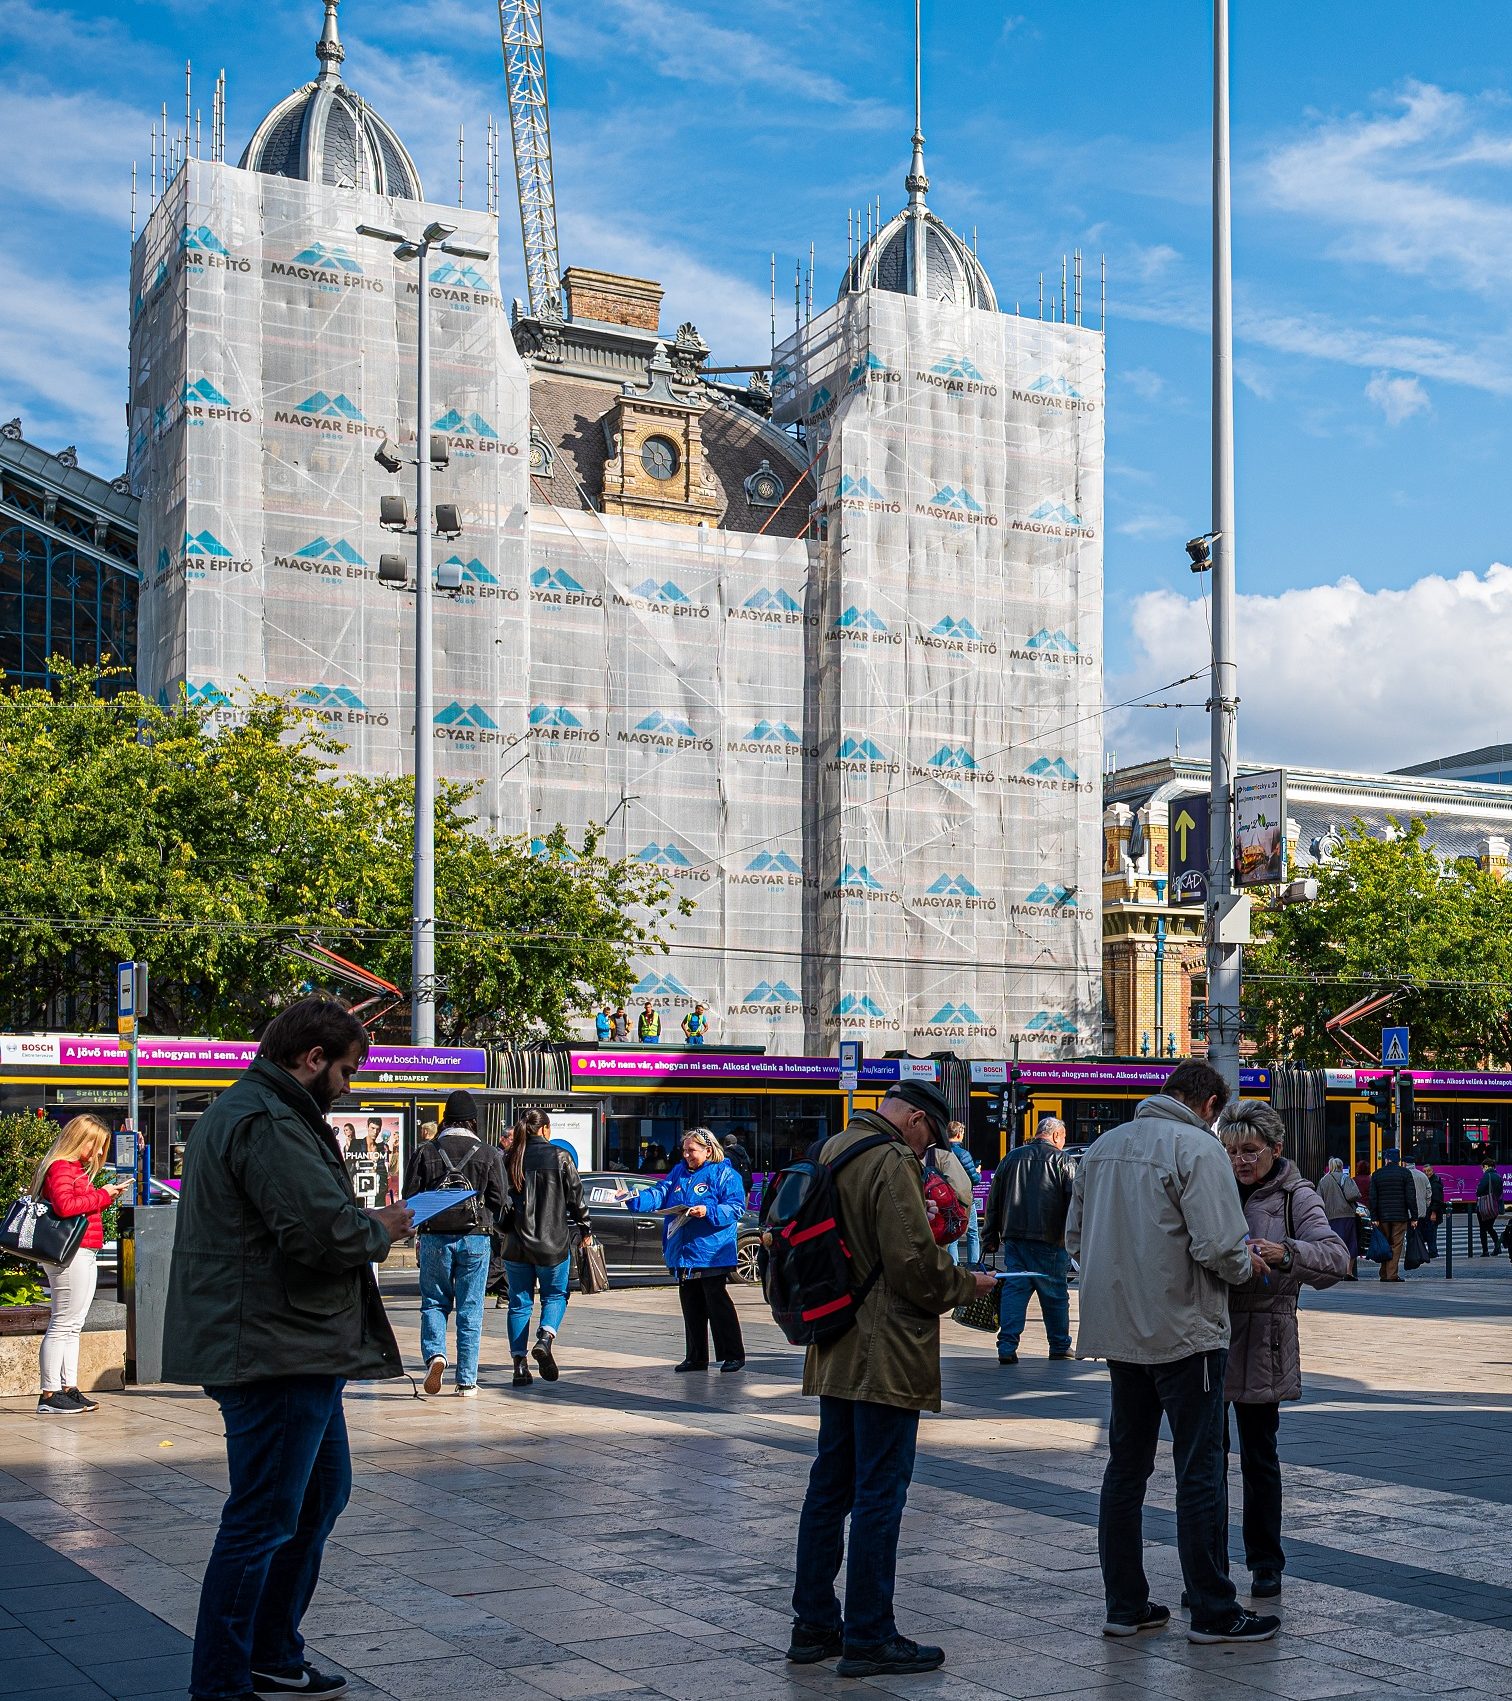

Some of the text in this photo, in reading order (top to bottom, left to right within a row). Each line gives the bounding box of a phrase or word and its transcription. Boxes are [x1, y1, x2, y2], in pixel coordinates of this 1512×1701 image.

[209, 254, 251, 273] ÉPÍTŐ
[271, 262, 384, 293] MAGYAR ÉPÍTŐ
[406, 283, 469, 303] MGYAR
[871, 370, 901, 383] ÉPÍTŐ
[916, 372, 998, 397] MAGYAR ÉPÍTŐ
[1012, 390, 1096, 412] MAGYAR ÉPÍTŐ
[208, 405, 252, 423] ÉPÍTŐ
[274, 411, 341, 432] MAGYAR
[321, 432, 343, 440] 1889
[410, 430, 519, 456] MYAR ÉPÍTŐ
[869, 500, 901, 513] ÉPÍTŐ
[916, 504, 998, 526] MAGYAR ÉPÍTŐ
[1012, 520, 1095, 538] MAGYAR ÉPÍTŐ
[210, 557, 253, 573] ÉPÍTŐ
[274, 556, 380, 581] MAGYAR ÉPÍT
[479, 584, 519, 601] ÉPÍTŐ
[528, 591, 603, 608] GYAR ÉPÍTŐ
[673, 603, 710, 618] ÉPÍTŐ
[727, 608, 820, 627] MAGYAR ÉPÍTŐ
[872, 631, 903, 645] ÉPÍTŐ
[915, 635, 997, 655] MAGYAR ÉPÍTŐ
[1010, 649, 1059, 663] MAGYAR
[347, 710, 389, 726] ÉPÍTŐ
[479, 730, 518, 746] ÉPÍTŐ
[528, 728, 600, 742] GYAR ÉPÍTŐ
[617, 731, 713, 751] MAGYAR ÉPÍTŐ
[727, 743, 820, 758] MAGYAR ÉPÍTŐ
[826, 760, 901, 774] MAGYAR ÉPÍTŐ
[964, 770, 995, 783] ÉPÍTŐ
[1008, 775, 1094, 794] MAGYAR ÉPÍTŐ
[729, 874, 783, 886] MAGYAR
[867, 888, 899, 902] ÉPÍTŐ
[912, 896, 997, 910] MAGYAR ÉPÍTŐ
[1010, 904, 1094, 920] MAGYAR ÉPÍTŐ
[626, 997, 670, 1007] AGYAR
[728, 1003, 818, 1016] MAGYAR ÉPÍTŐ
[870, 1017, 900, 1030] ÉPÍTŐ
[913, 1024, 997, 1037] MAGYAR ÉPÍTŐ
[66, 1047, 75, 1057] A
[77, 1047, 101, 1059] jövő
[103, 1049, 127, 1057] nem
[151, 1049, 196, 1060] ahogyan
[198, 1050, 212, 1059] mi
[213, 1052, 239, 1060] sem.
[369, 1055, 462, 1066] www.bosch.hu/karrier
[589, 1060, 597, 1068] A
[618, 1061, 636, 1069] nem
[654, 1061, 689, 1071] ahogyan
[690, 1062, 701, 1070] mi
[722, 1063, 750, 1071] Alkosd
[751, 1063, 777, 1072] velünk
[784, 1064, 822, 1073] holnapot:
[1061, 1070, 1089, 1079] ahogyan
[1115, 1071, 1138, 1079] Alkosd
[1139, 1072, 1160, 1080] velünk
[1447, 1078, 1465, 1086] Alkosd
[1465, 1078, 1484, 1086] velünk
[56, 1089, 65, 1103] 4
[76, 1089, 129, 1097] Széll Kálmá
[346, 1151, 388, 1160] PHANTOM
